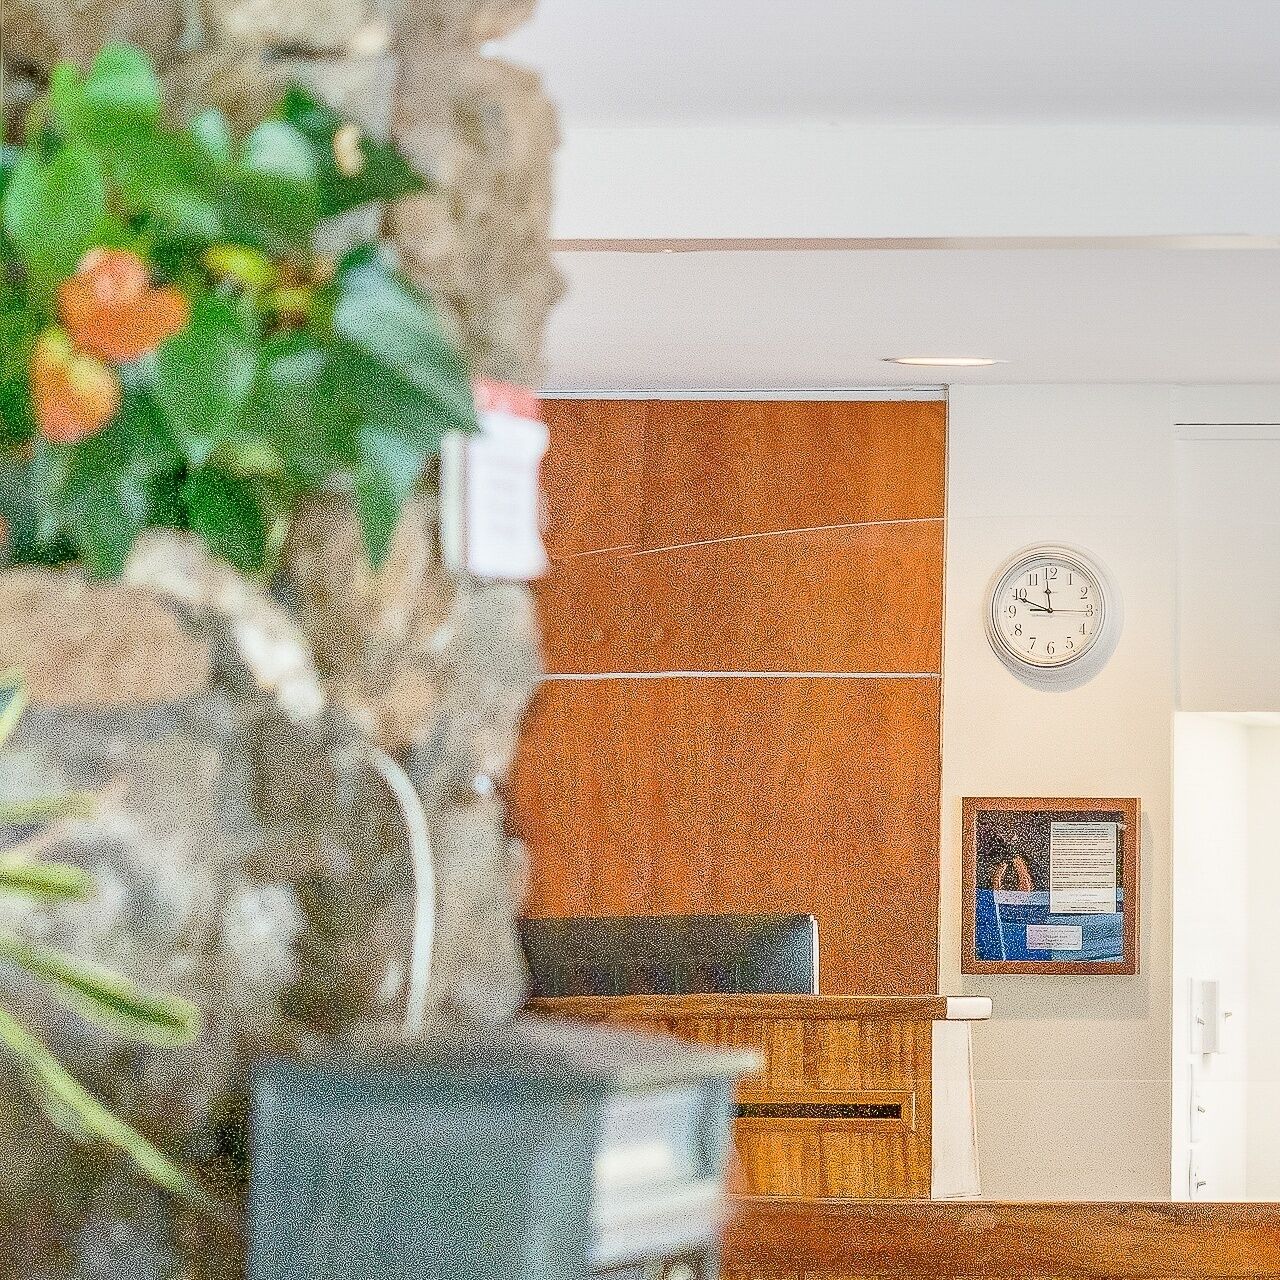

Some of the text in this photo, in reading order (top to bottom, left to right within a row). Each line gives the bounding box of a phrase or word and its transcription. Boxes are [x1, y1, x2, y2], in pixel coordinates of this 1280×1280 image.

[1027, 573, 1038, 586] 11
[1045, 567, 1058, 580] 12
[1068, 573, 1073, 586] 1
[1013, 588, 1027, 601] 10
[1080, 586, 1088, 600] 2
[1008, 605, 1017, 618] 9
[1085, 603, 1094, 617] 3
[1014, 623, 1023, 637] 8
[1078, 623, 1086, 635] 4
[1029, 637, 1037, 650] 7
[1046, 641, 1055, 655] 6
[1065, 636, 1074, 649] 5
